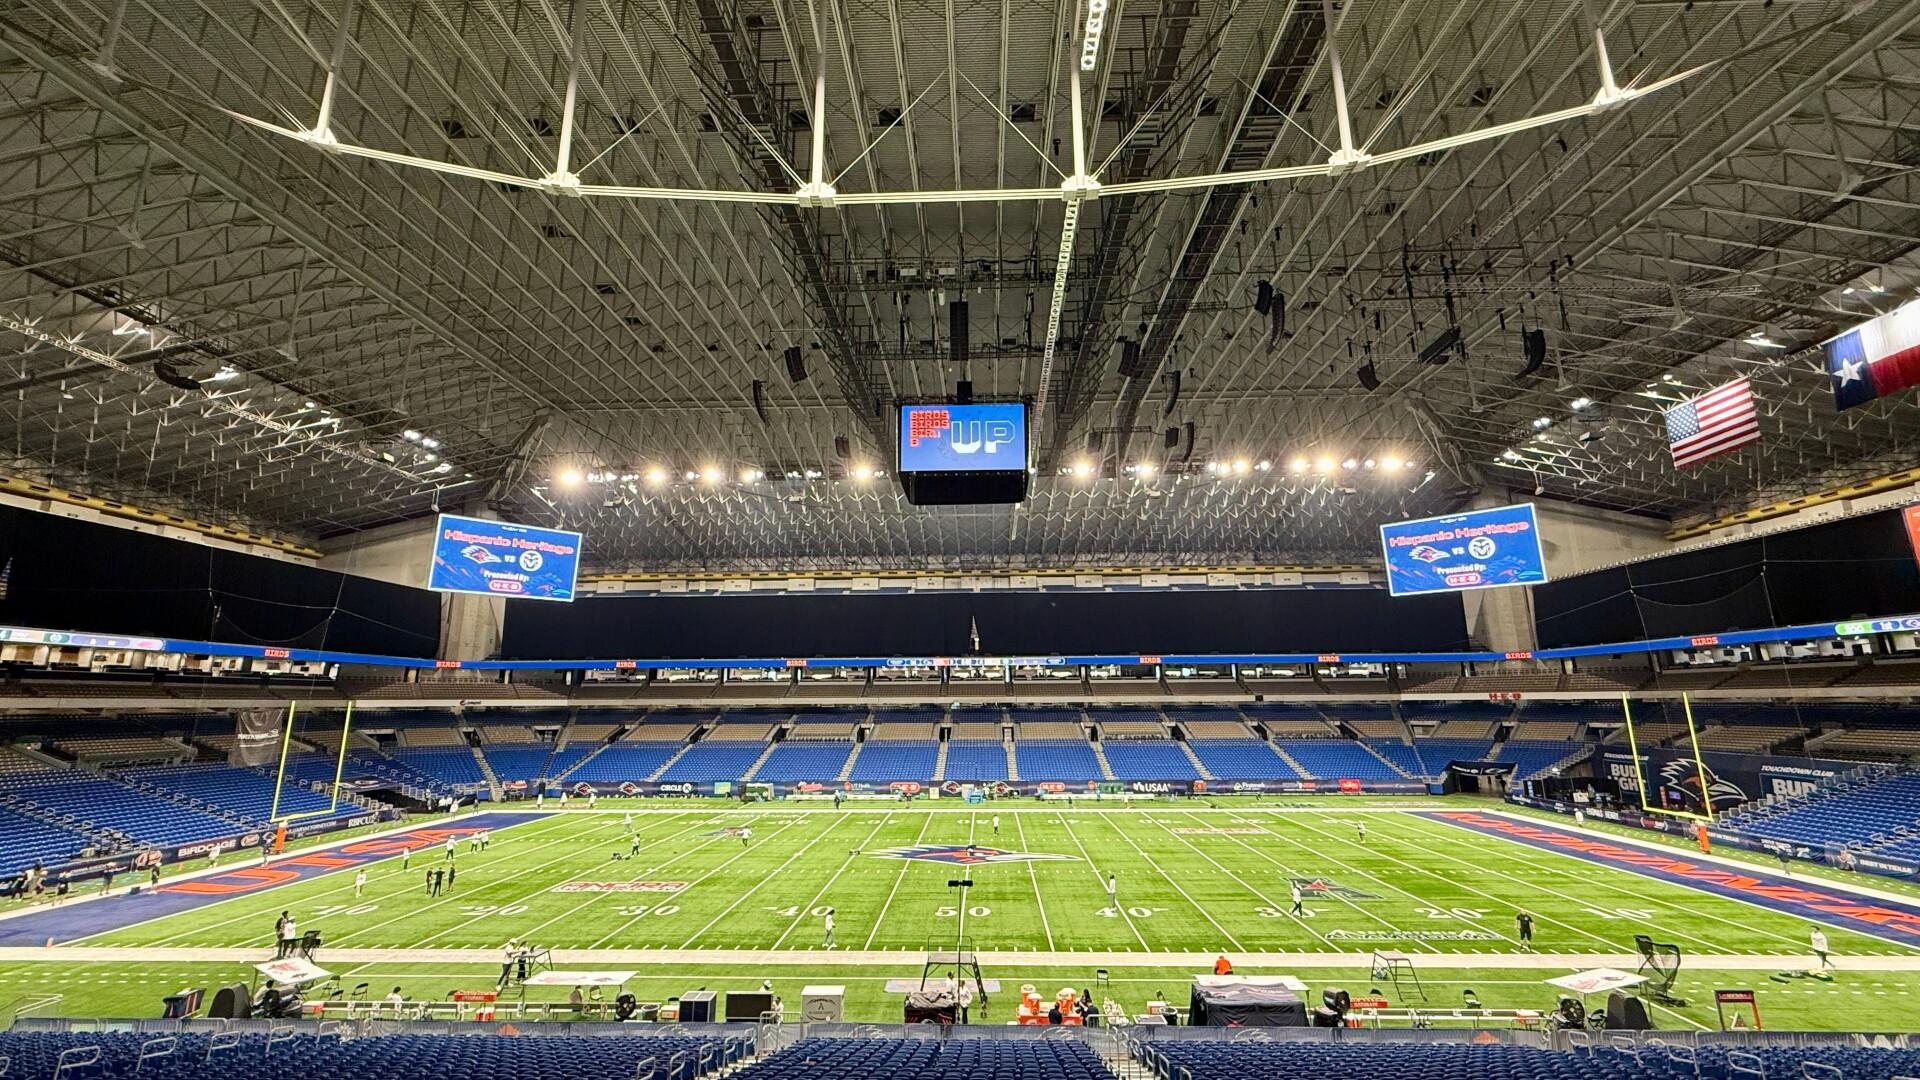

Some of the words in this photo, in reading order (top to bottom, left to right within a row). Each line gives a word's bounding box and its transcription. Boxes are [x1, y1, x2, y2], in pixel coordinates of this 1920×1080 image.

[910, 411, 949, 420] BIRDS
[910, 420, 949, 429] BIRDS
[951, 420, 1016, 453] UP
[1389, 530, 1454, 547] Hispanic
[1455, 521, 1530, 538] Heritage
[444, 529, 511, 546] Hispanic
[512, 538, 574, 555] Heritage
[1691, 636, 1718, 646] BIRDS
[264, 648, 290, 658] BIRDS
[616, 660, 637, 668] BIRDS
[786, 659, 807, 667] BIRDS
[1140, 656, 1161, 664] BIRDS
[1488, 692, 1522, 701] H-E-B
[1761, 764, 1812, 775] TOUCHDOWN
[1812, 769, 1835, 778] CLUB
[660, 784, 683, 792] CIRCLE
[1145, 783, 1169, 792] USAA
[177, 839, 237, 858] BIRDCAGE
[1431, 812, 1920, 936] ROADRUNNER
[312, 904, 379, 915] 10
[459, 905, 529, 916] 20
[619, 905, 681, 916] 30
[776, 905, 834, 917] 40
[935, 906, 991, 917] 50
[1095, 906, 1152, 918] 40
[1254, 906, 1316, 918] 30
[1414, 907, 1483, 919] 20
[1580, 907, 1652, 919] 10
